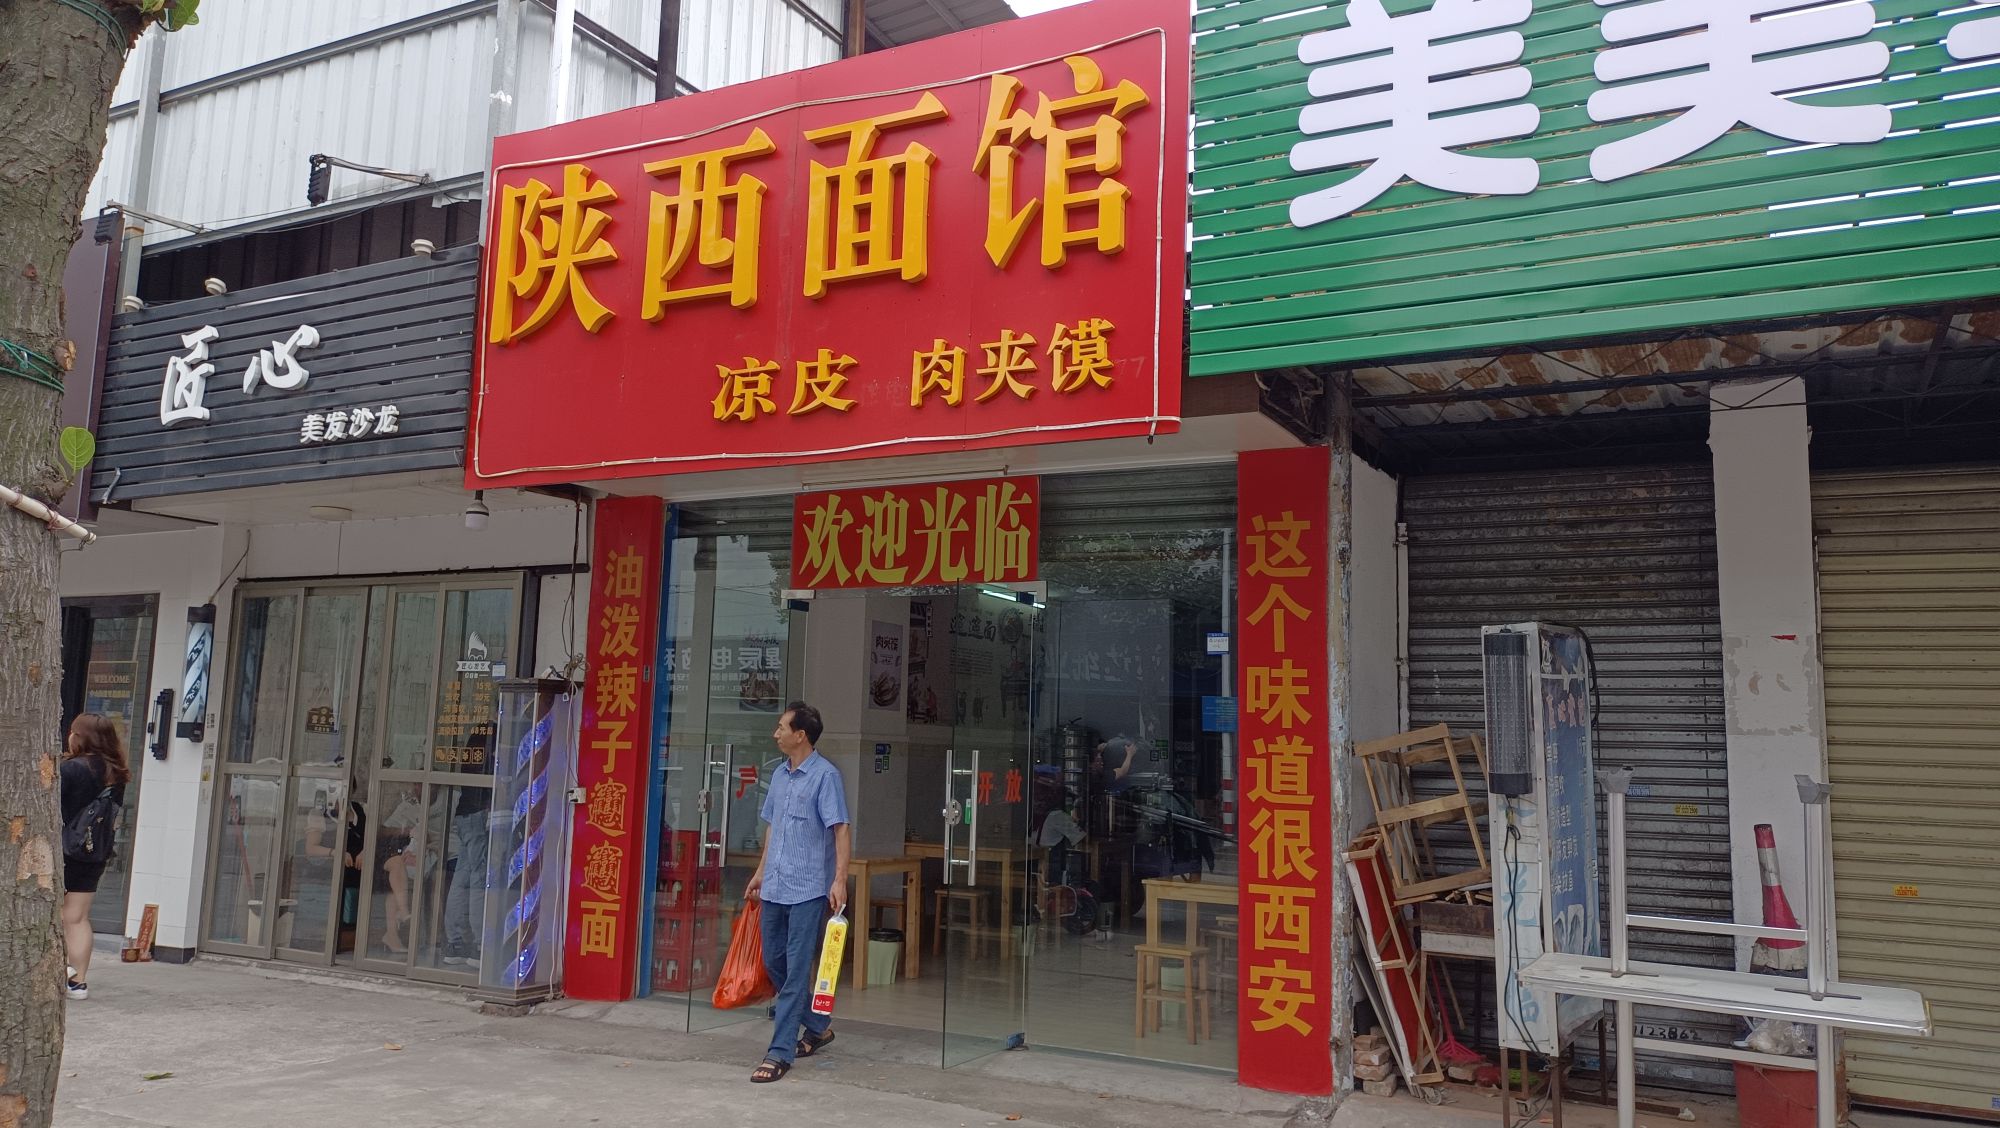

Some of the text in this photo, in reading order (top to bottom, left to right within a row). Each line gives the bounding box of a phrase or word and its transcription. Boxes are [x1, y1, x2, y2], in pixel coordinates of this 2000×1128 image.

[490, 55, 1151, 345] 陕西面馆
[161, 325, 320, 426] 匠心
[711, 318, 1116, 423] 凉皮 肉夹馍
[300, 405, 400, 444] 美发沙龙
[799, 481, 1033, 588] 欢迎光临
[979, 768, 1023, 805] 开放
[1246, 511, 1318, 1037] 这个味道很西安
